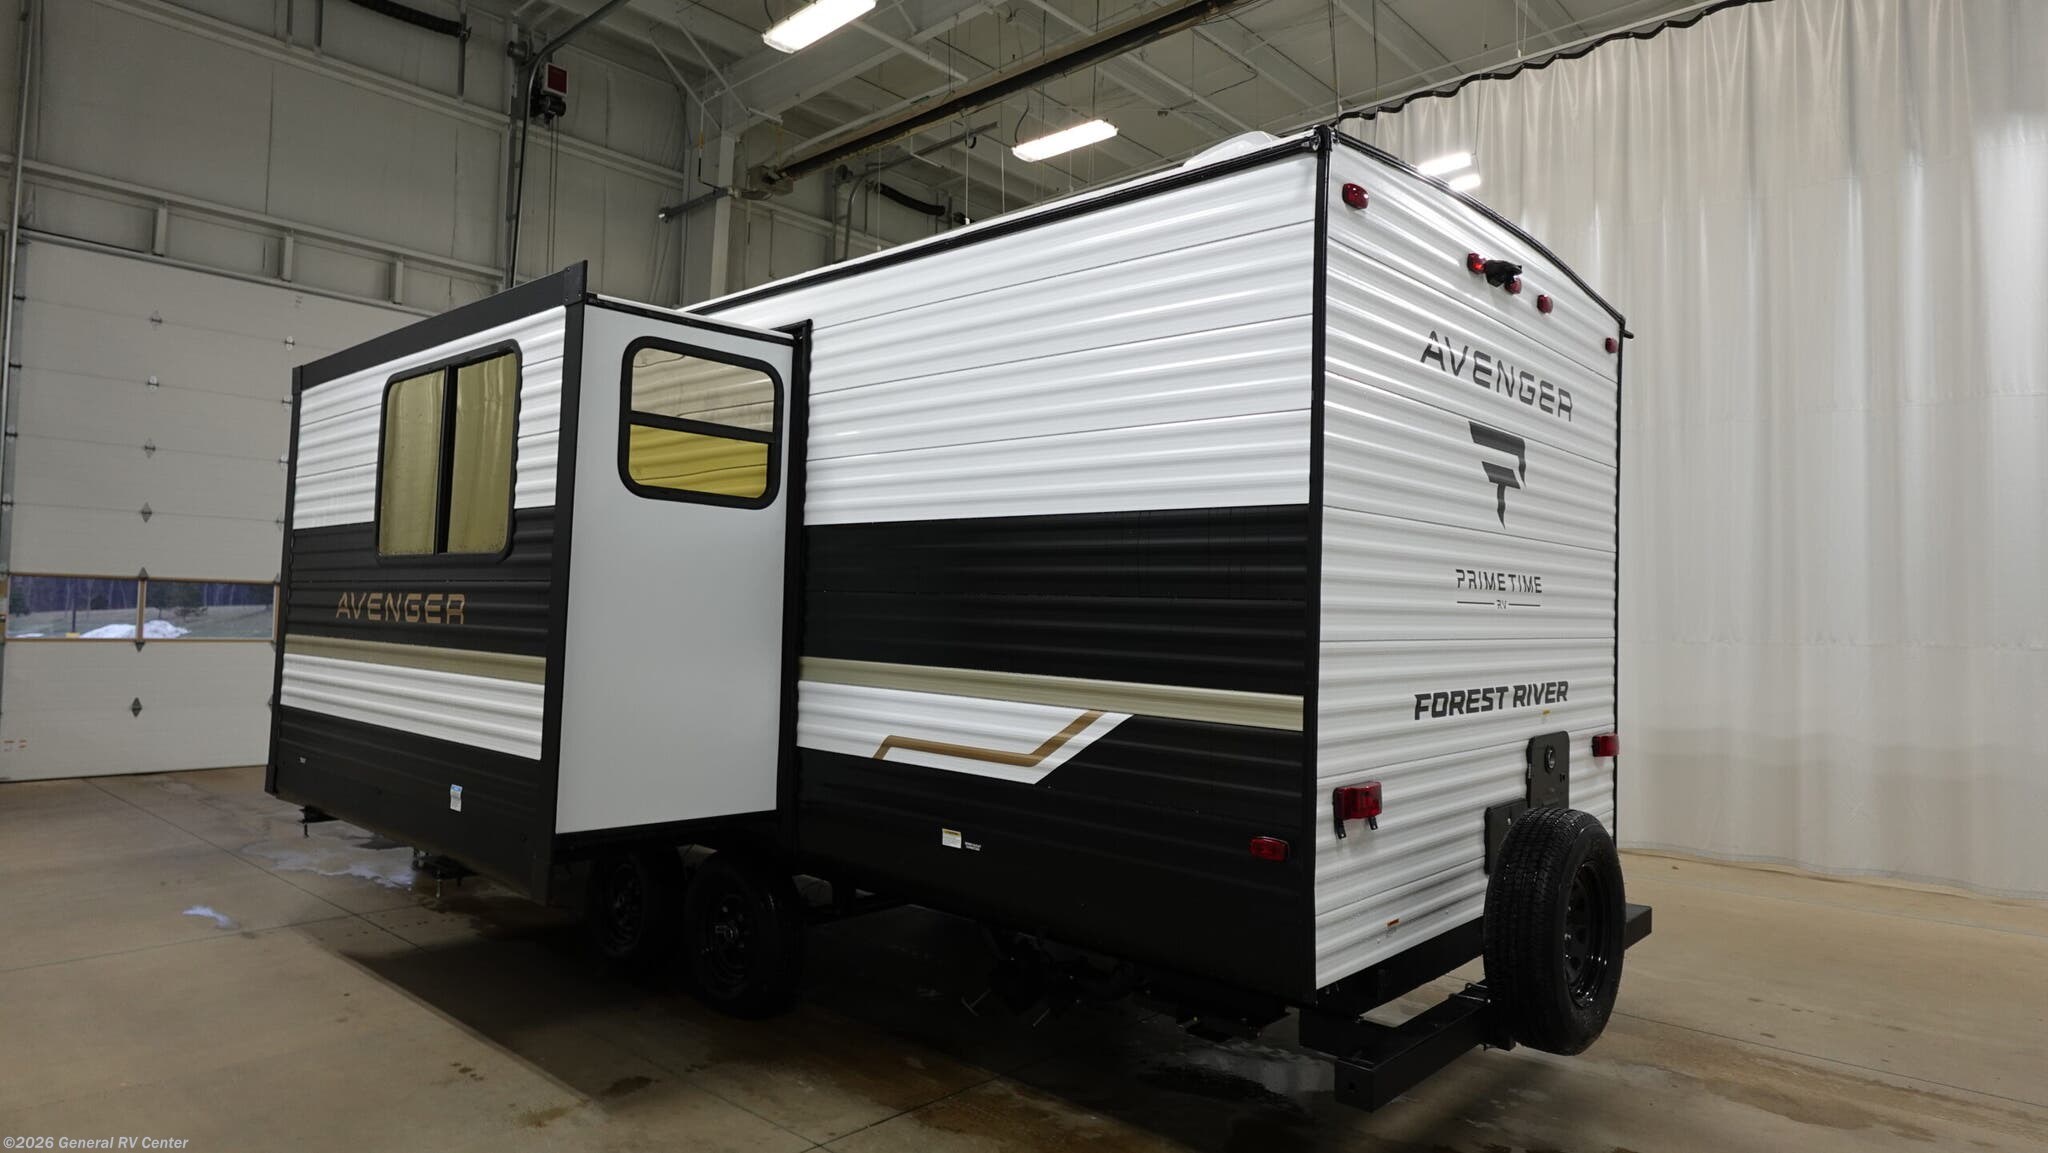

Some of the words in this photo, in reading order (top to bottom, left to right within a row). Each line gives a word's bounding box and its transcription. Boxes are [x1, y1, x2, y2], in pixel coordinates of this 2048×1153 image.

[1420, 330, 1573, 422] AVENGER
[335, 591, 466, 625] AVENGER
[1496, 599, 1508, 610] RV
[1414, 686, 1509, 721] FOREST
[1512, 680, 1569, 708] RIVER
